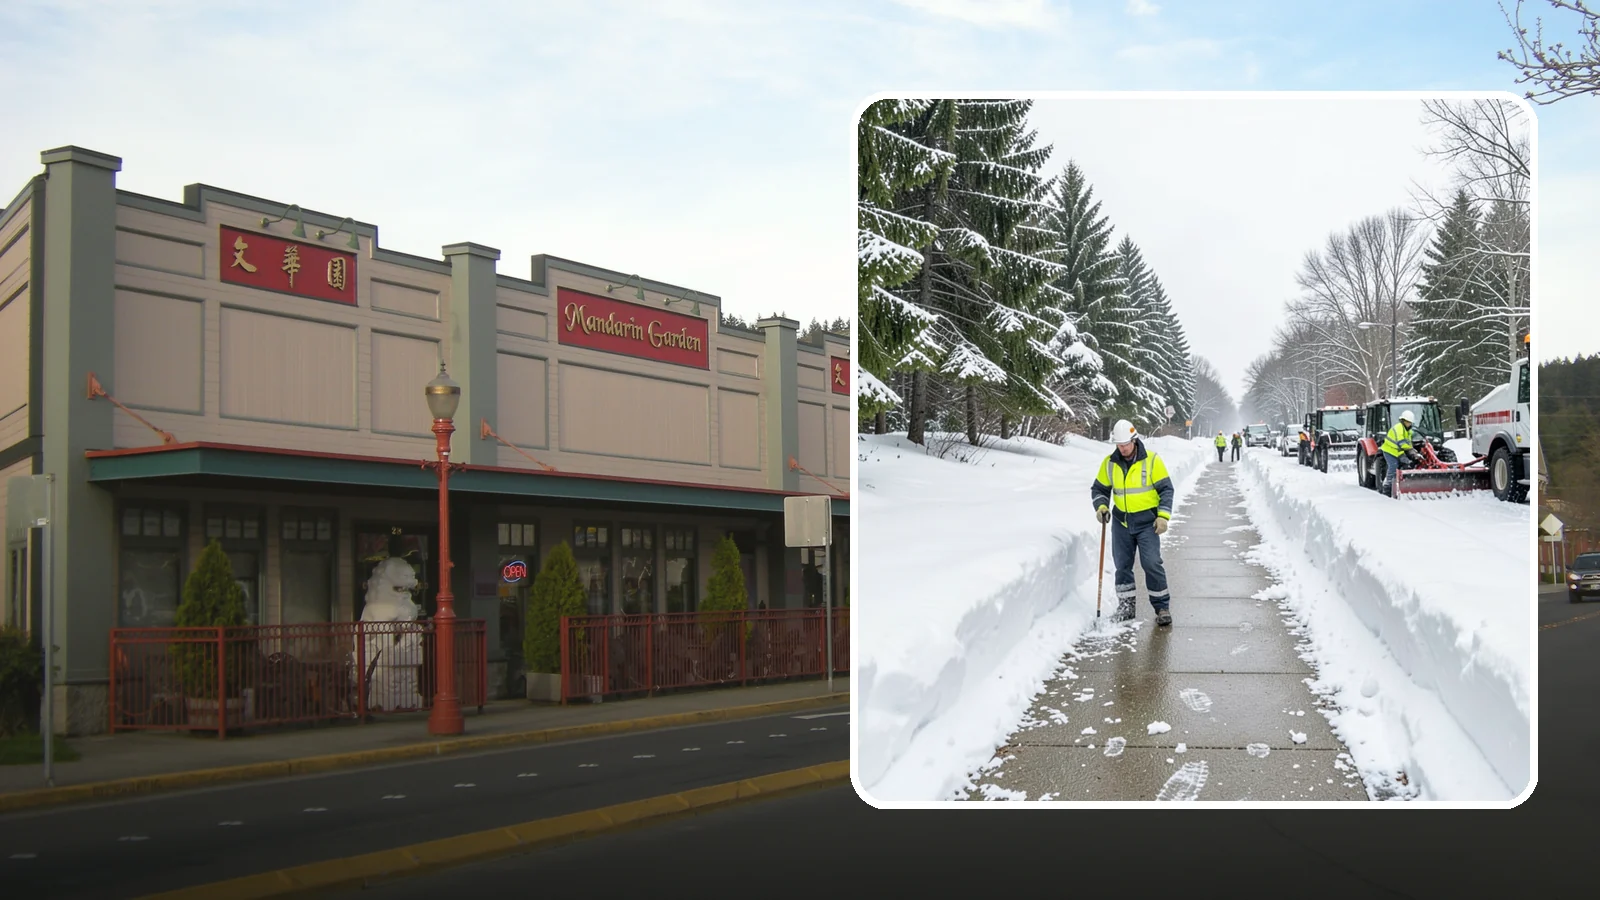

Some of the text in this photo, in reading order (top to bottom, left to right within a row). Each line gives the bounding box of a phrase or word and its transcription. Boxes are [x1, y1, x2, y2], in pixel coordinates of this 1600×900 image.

[231, 236, 345, 290] 文華園
[564, 302, 701, 352] Mandarin Garden
[835, 363, 846, 386] 文
[504, 566, 526, 577] OPEN
